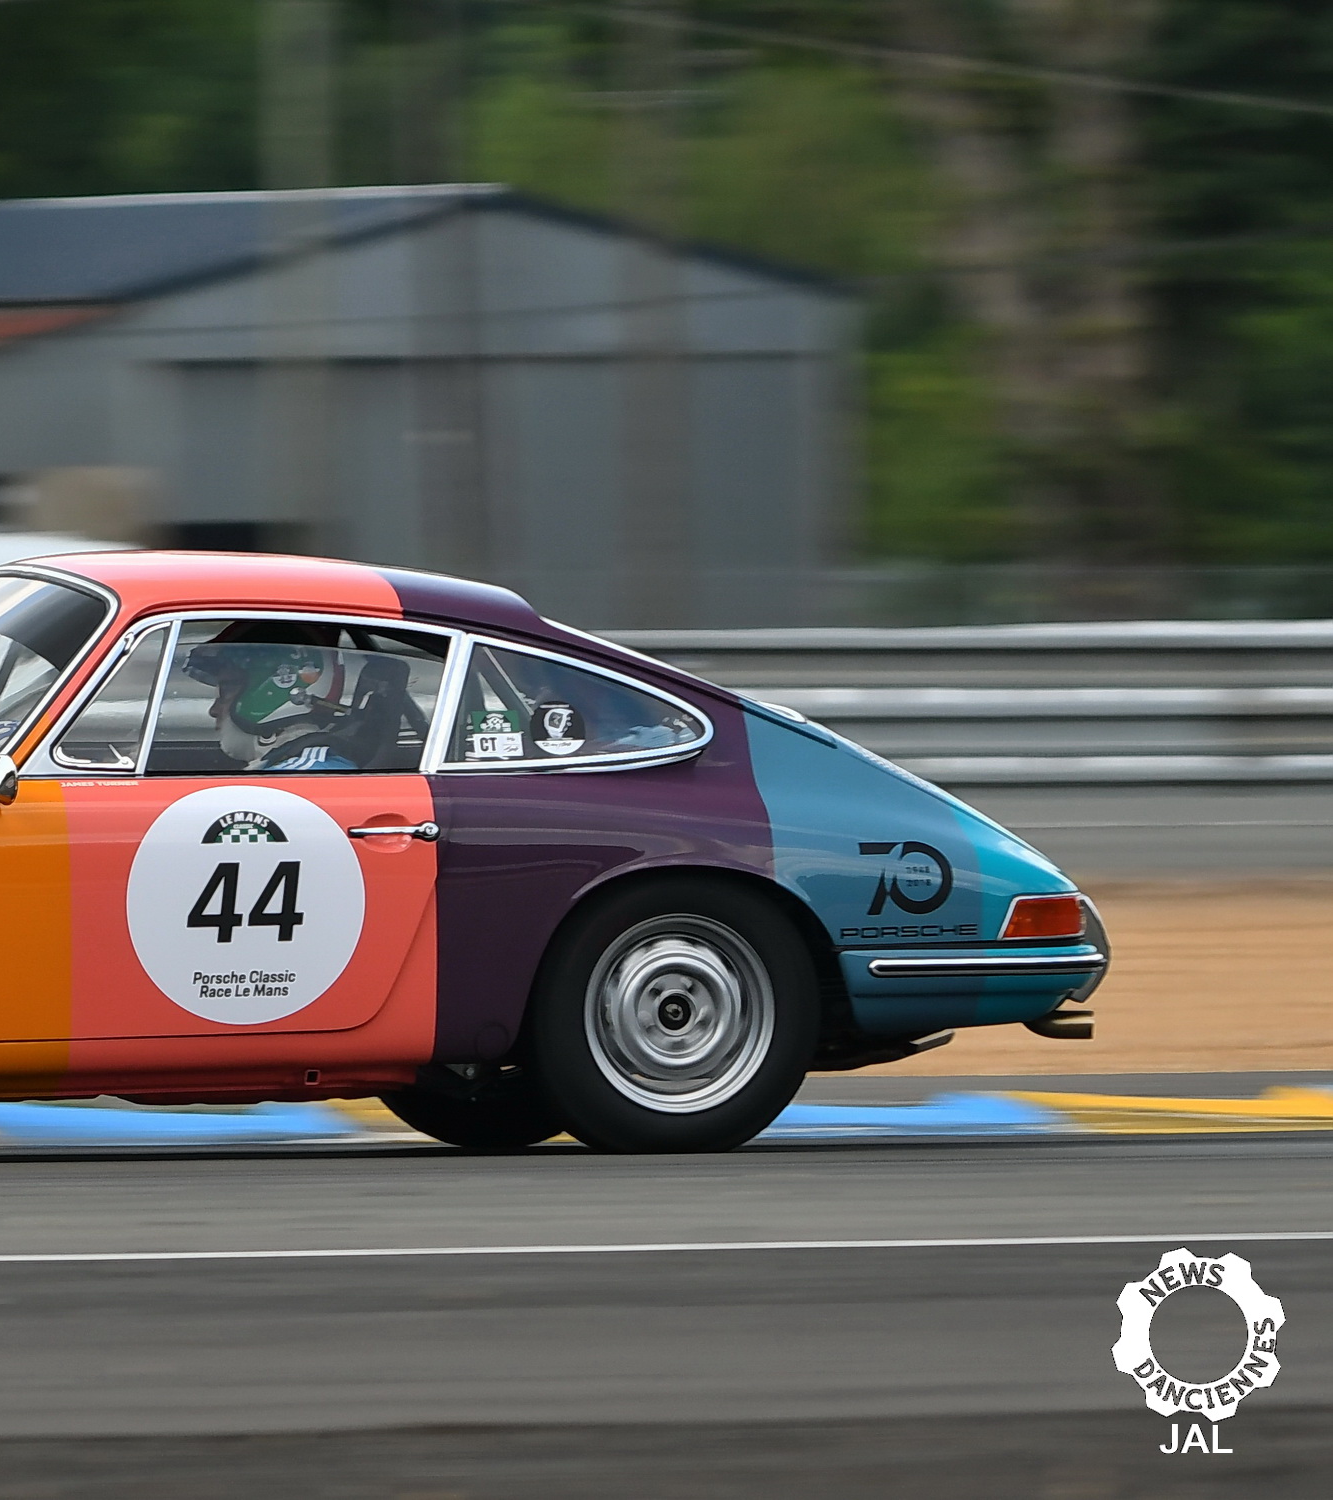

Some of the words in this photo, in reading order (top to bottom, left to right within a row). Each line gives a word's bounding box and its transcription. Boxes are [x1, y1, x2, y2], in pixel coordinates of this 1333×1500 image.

[479, 737, 497, 752] CT
[219, 814, 234, 828] LE
[234, 812, 270, 828] MANS
[858, 841, 953, 915] 70
[187, 861, 304, 943] 44
[840, 923, 978, 940] PORSCHE
[193, 971, 246, 984] Porsche
[249, 969, 296, 983] Classic
[199, 985, 232, 998] Race
[234, 985, 250, 997] Le
[253, 984, 289, 997] Mans
